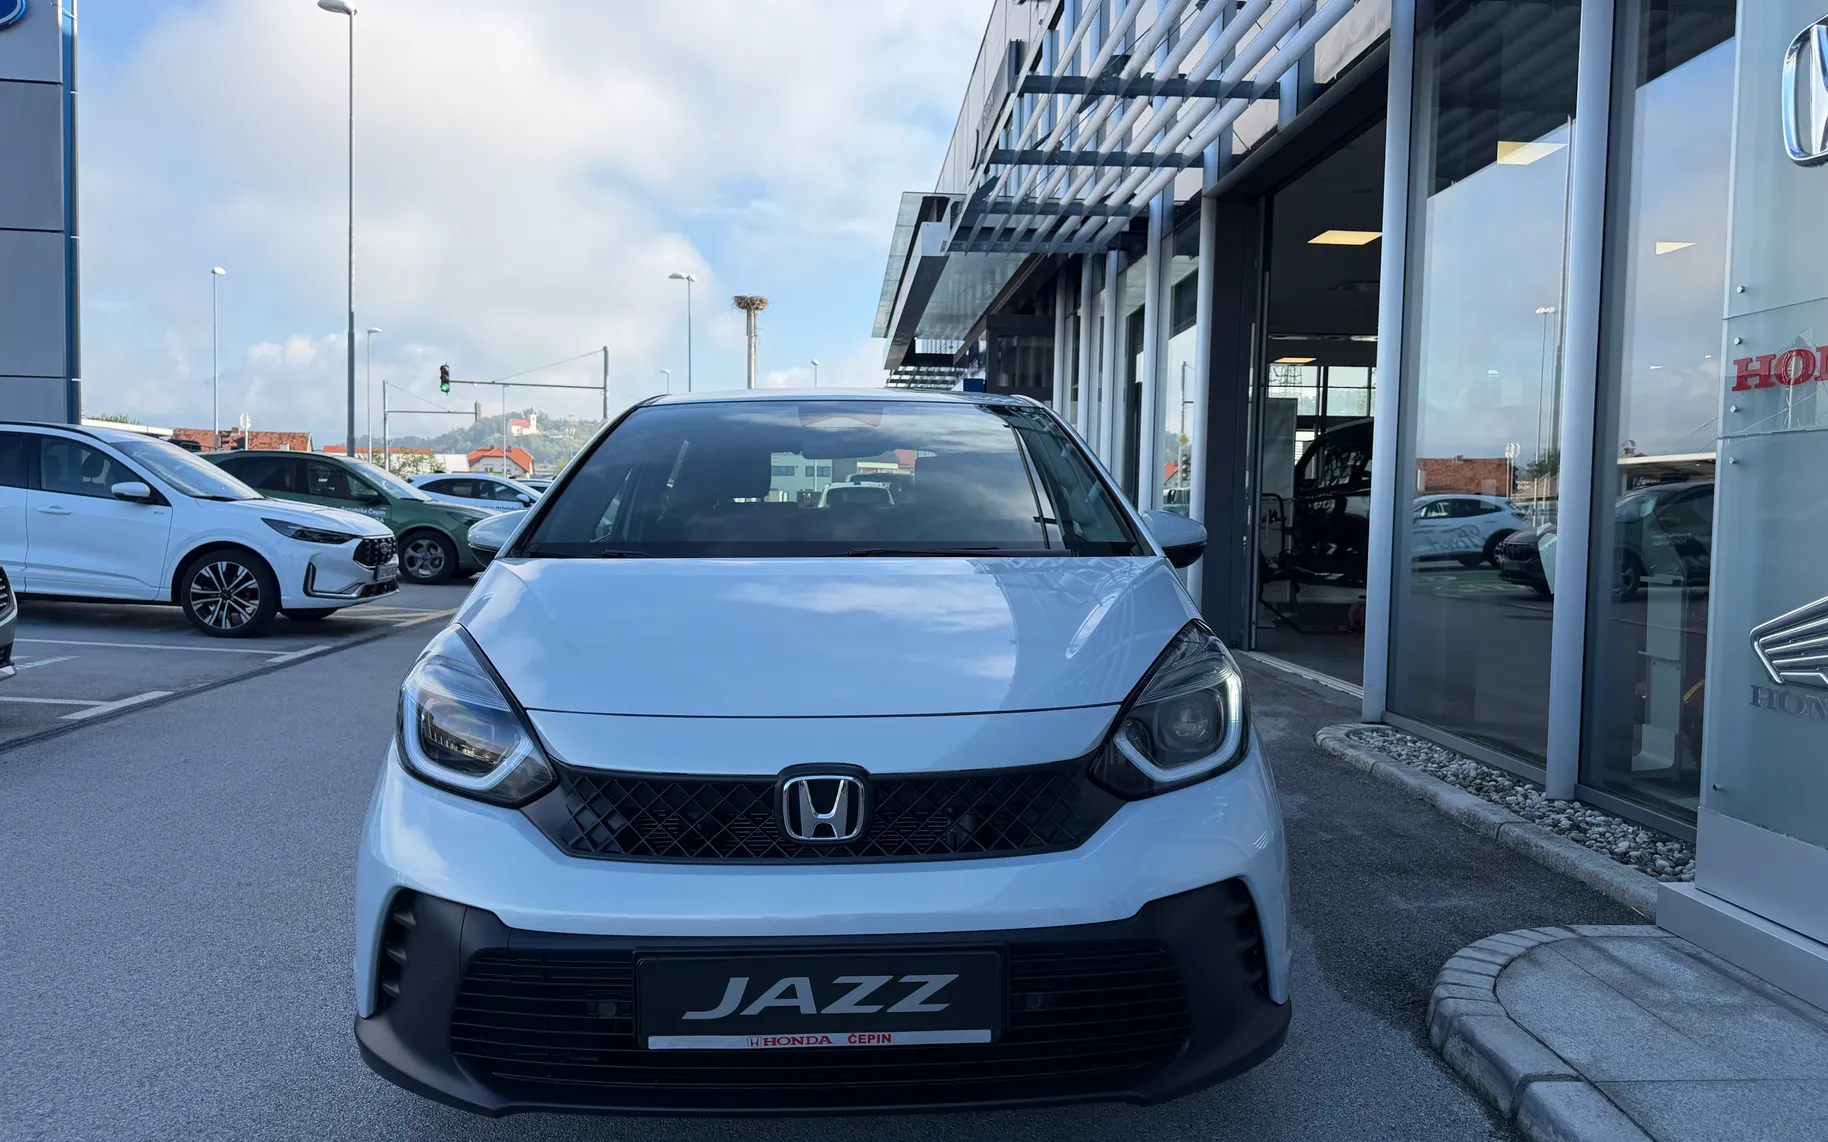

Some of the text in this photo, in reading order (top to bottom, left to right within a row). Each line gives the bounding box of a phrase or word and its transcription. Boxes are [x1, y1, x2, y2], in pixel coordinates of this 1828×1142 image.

[681, 974, 960, 1020] JAZZ
[763, 1035, 833, 1047] HONDA
[847, 1032, 892, 1044] ČEPIN
